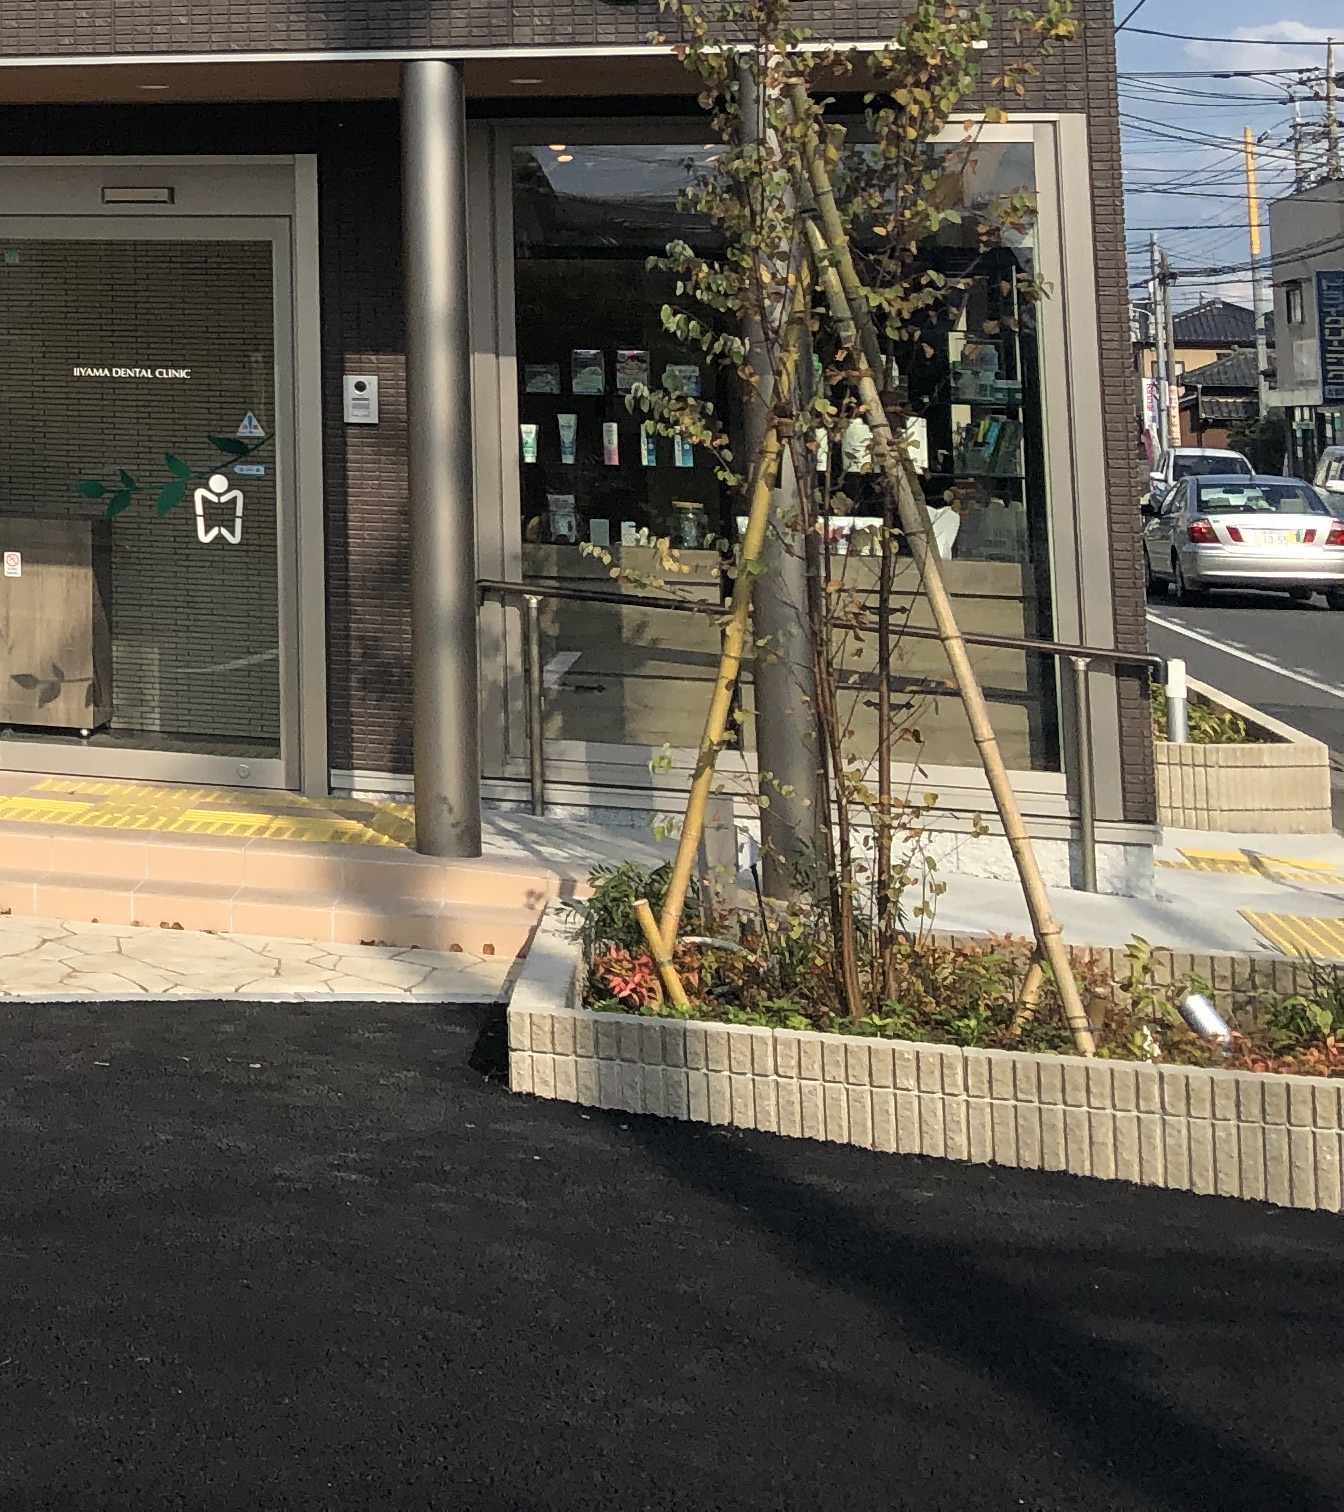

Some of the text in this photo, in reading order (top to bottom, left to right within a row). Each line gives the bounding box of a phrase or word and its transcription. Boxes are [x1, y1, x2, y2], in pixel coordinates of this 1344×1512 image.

[73, 367, 192, 379] IIYAMA DENTAL CLINIC
